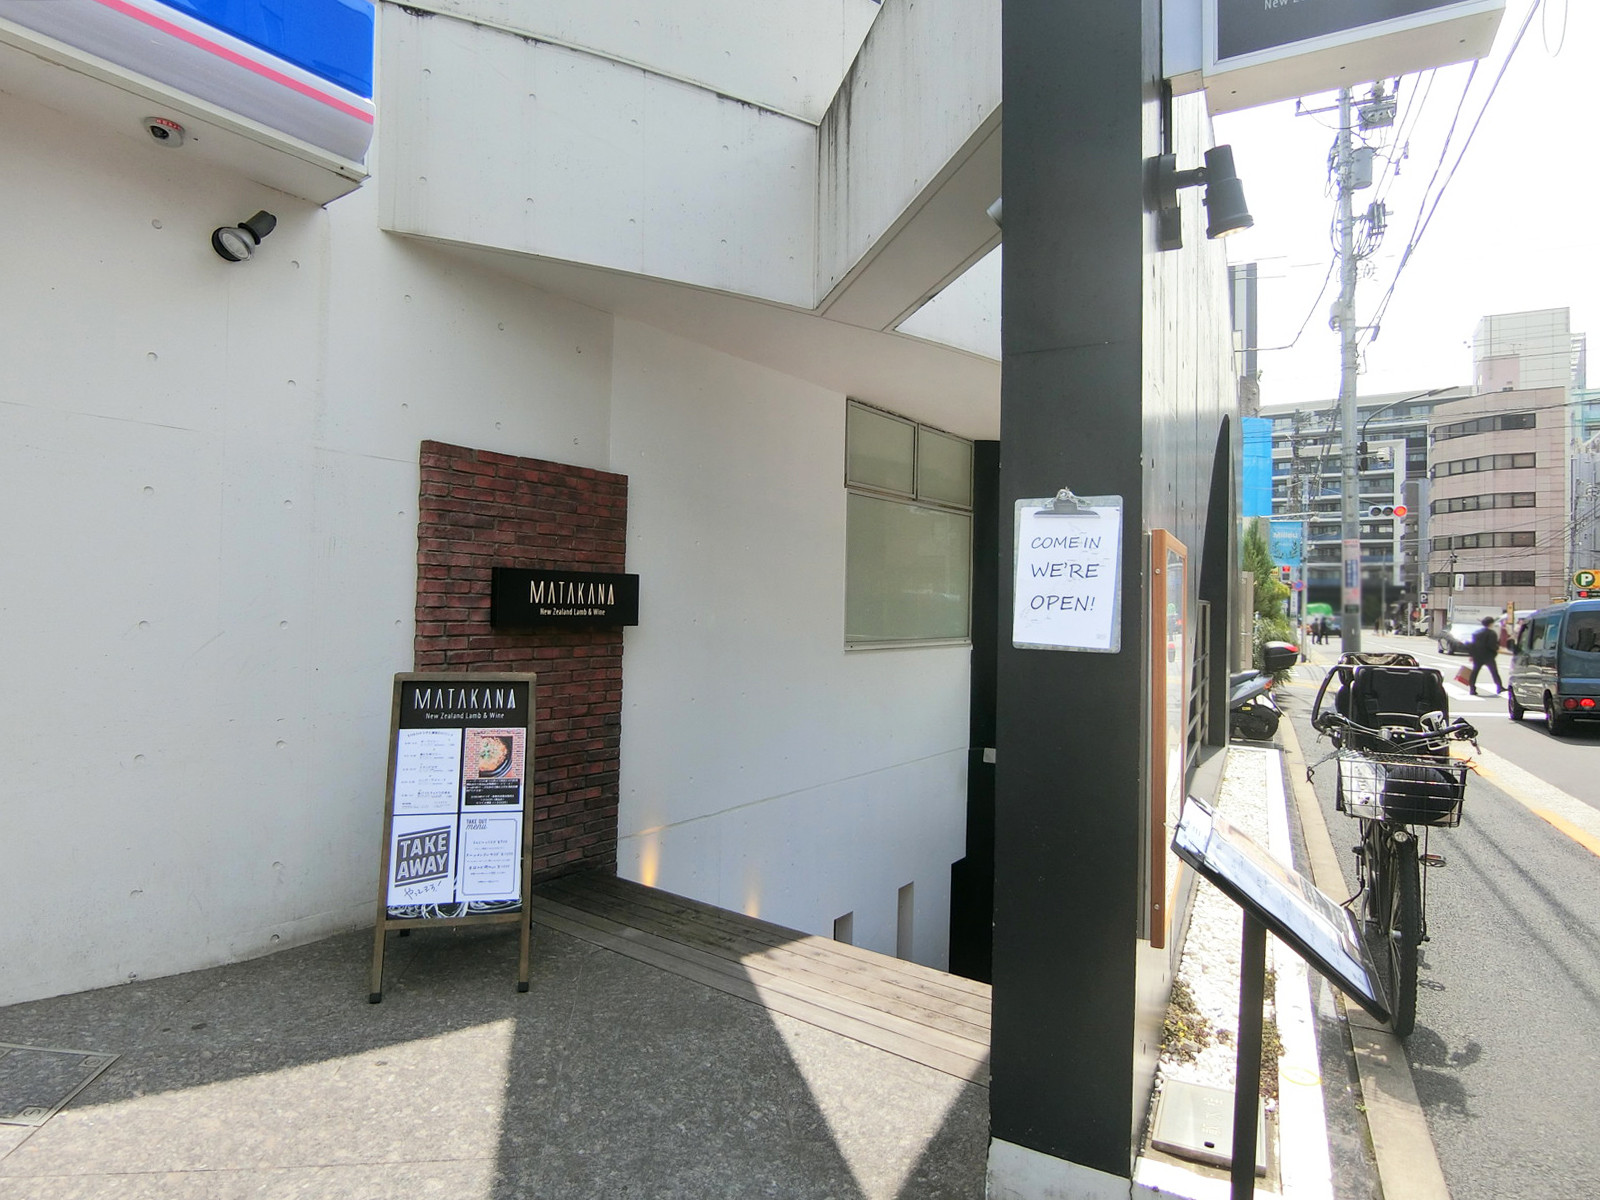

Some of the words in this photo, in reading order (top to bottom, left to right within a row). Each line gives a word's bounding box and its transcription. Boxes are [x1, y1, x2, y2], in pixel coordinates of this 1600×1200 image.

[1031, 536, 1080, 549] COME
[1083, 536, 1102, 549] IN
[1031, 562, 1100, 579] WE'RE
[1580, 573, 1593, 586] P
[529, 580, 615, 605] MATAKANA
[539, 607, 552, 616] New
[552, 607, 573, 616] Zealand
[573, 608, 587, 616] Lamb
[587, 608, 592, 616] &
[592, 608, 606, 616] Wine
[1030, 595, 1096, 611] OPEN!
[414, 688, 516, 709] MATAKANA
[400, 833, 448, 858] TAKE
[397, 853, 448, 879] AWAY
